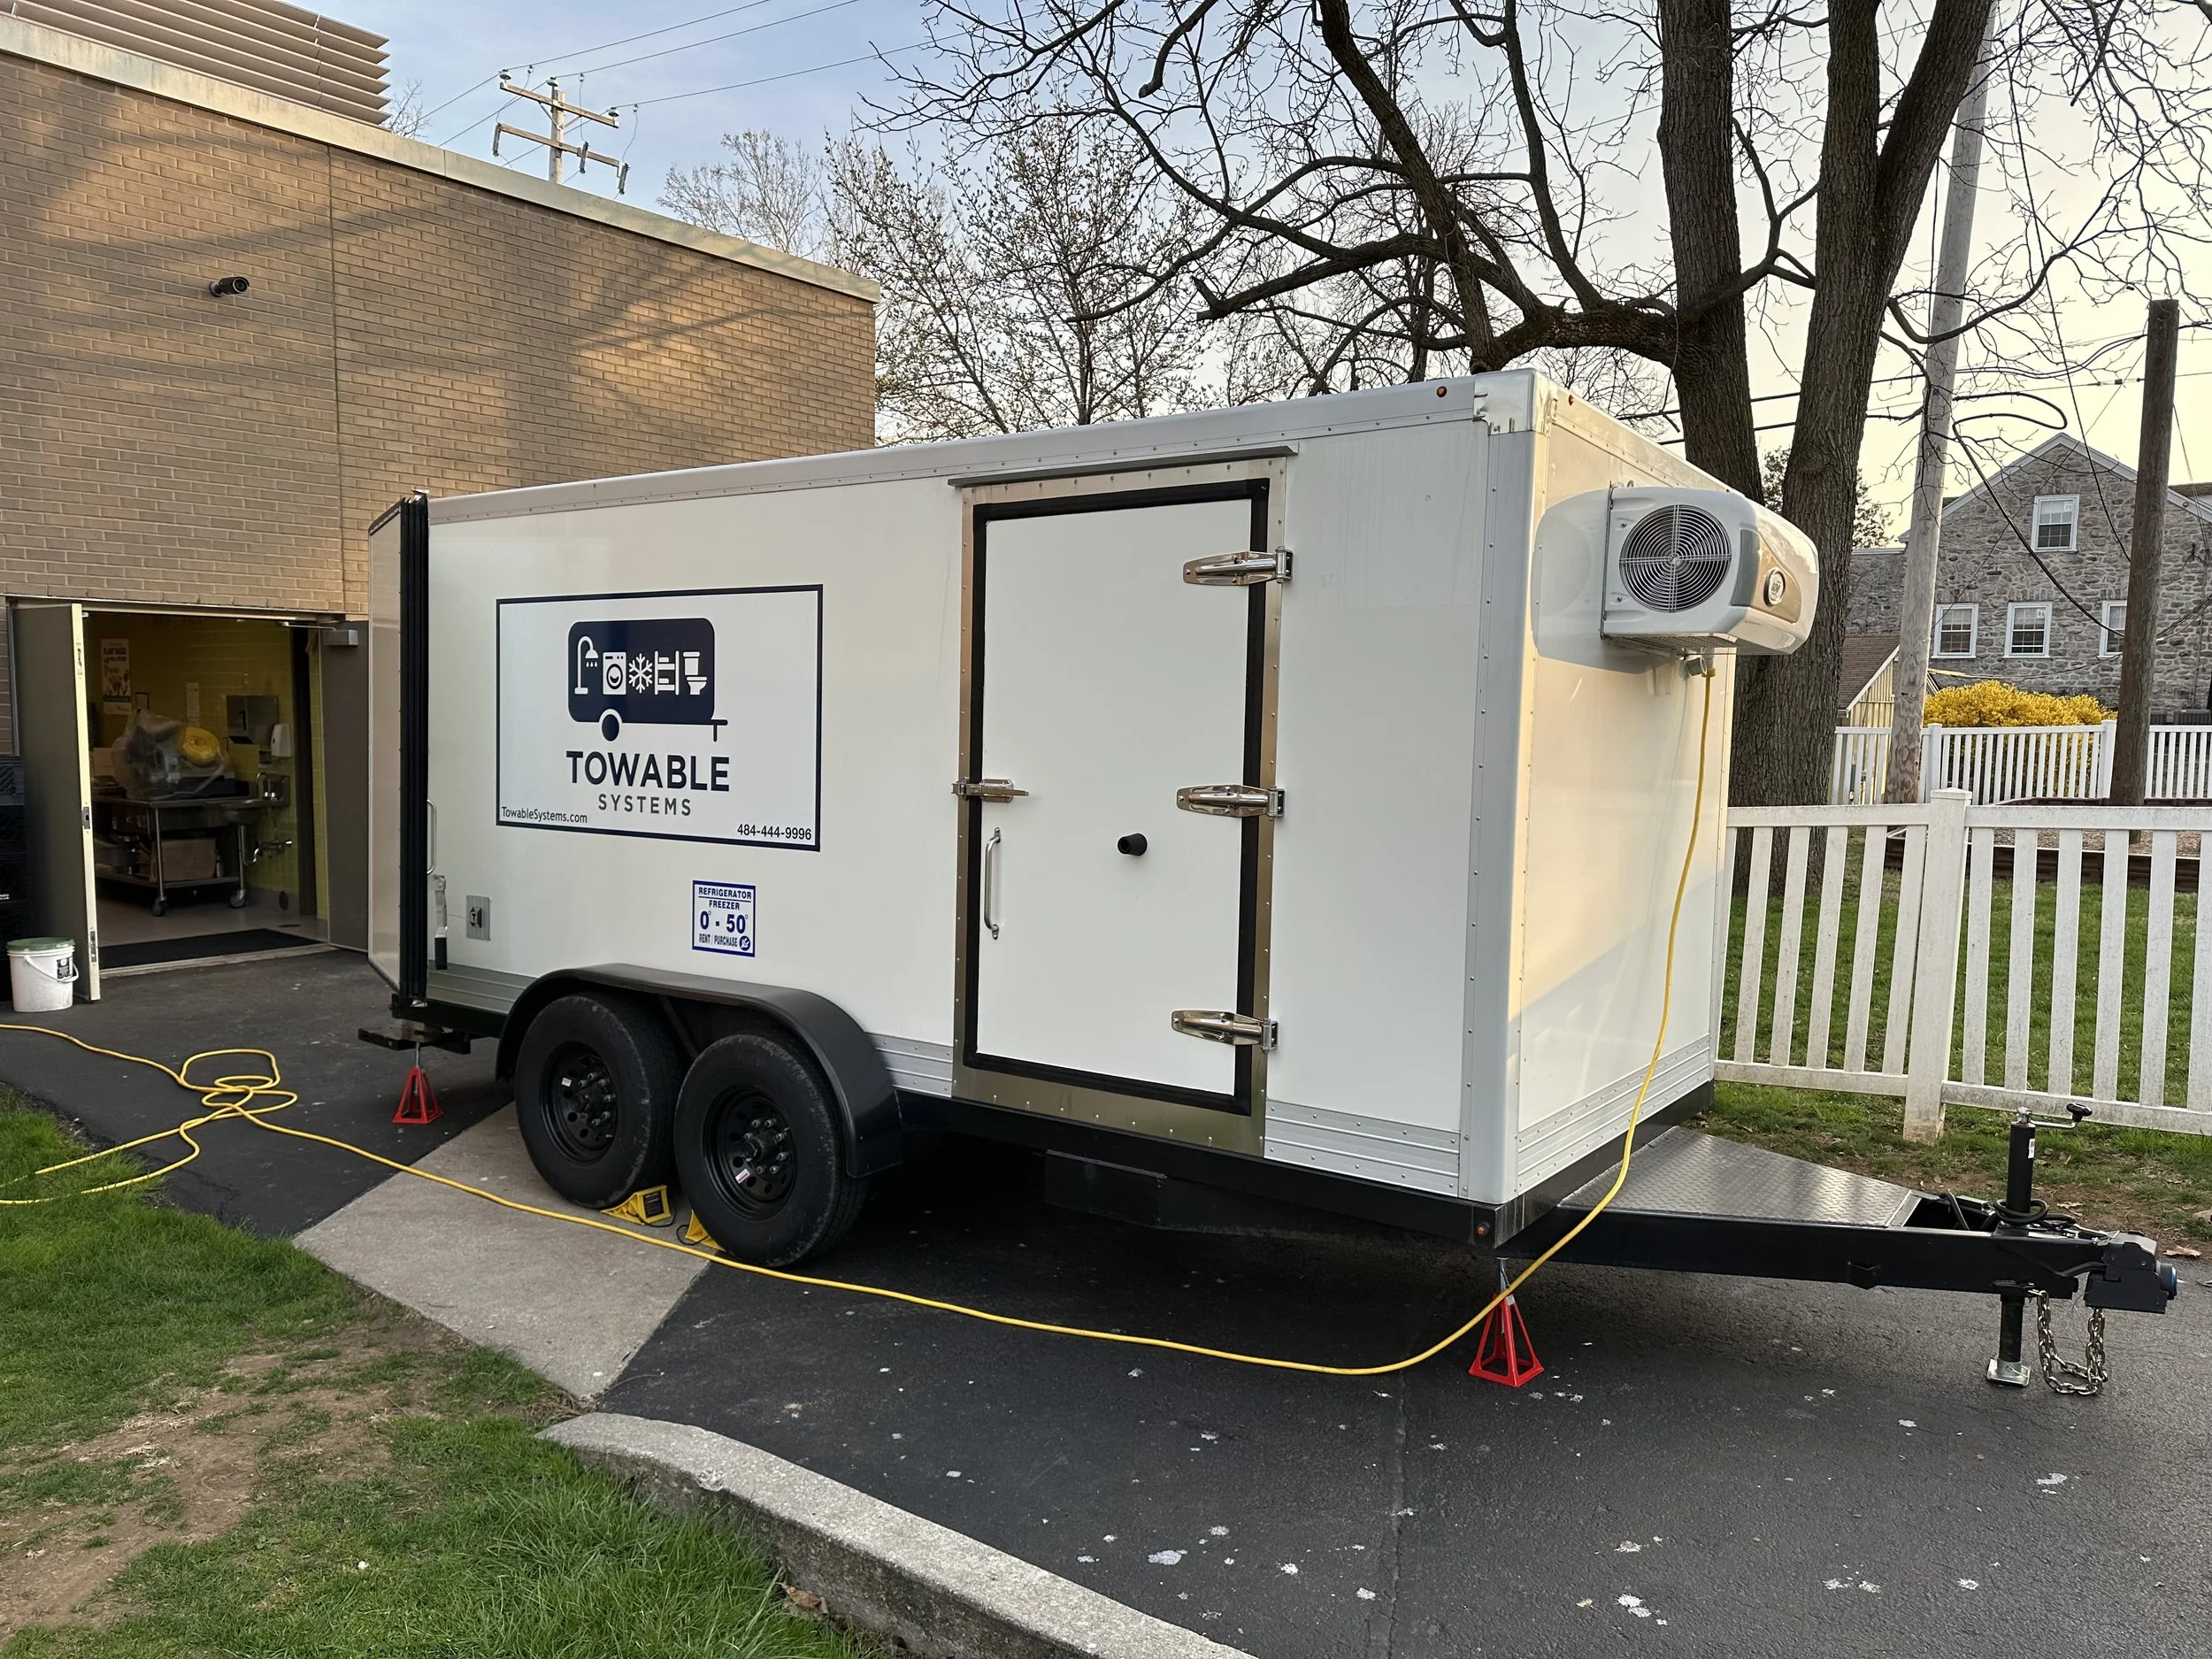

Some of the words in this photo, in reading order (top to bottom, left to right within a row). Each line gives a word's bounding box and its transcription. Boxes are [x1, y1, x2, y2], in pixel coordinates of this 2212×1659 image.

[566, 750, 730, 792] TOWABLE
[598, 794, 691, 816] SYSTEMS
[501, 806, 588, 824] TowableSystems.com
[737, 824, 812, 841] 484-444-9996
[698, 887, 751, 899] REFRIGERATOR
[709, 900, 740, 910] FREEZER
[699, 933, 710, 943] RENT
[714, 934, 738, 947] PURCHASE
